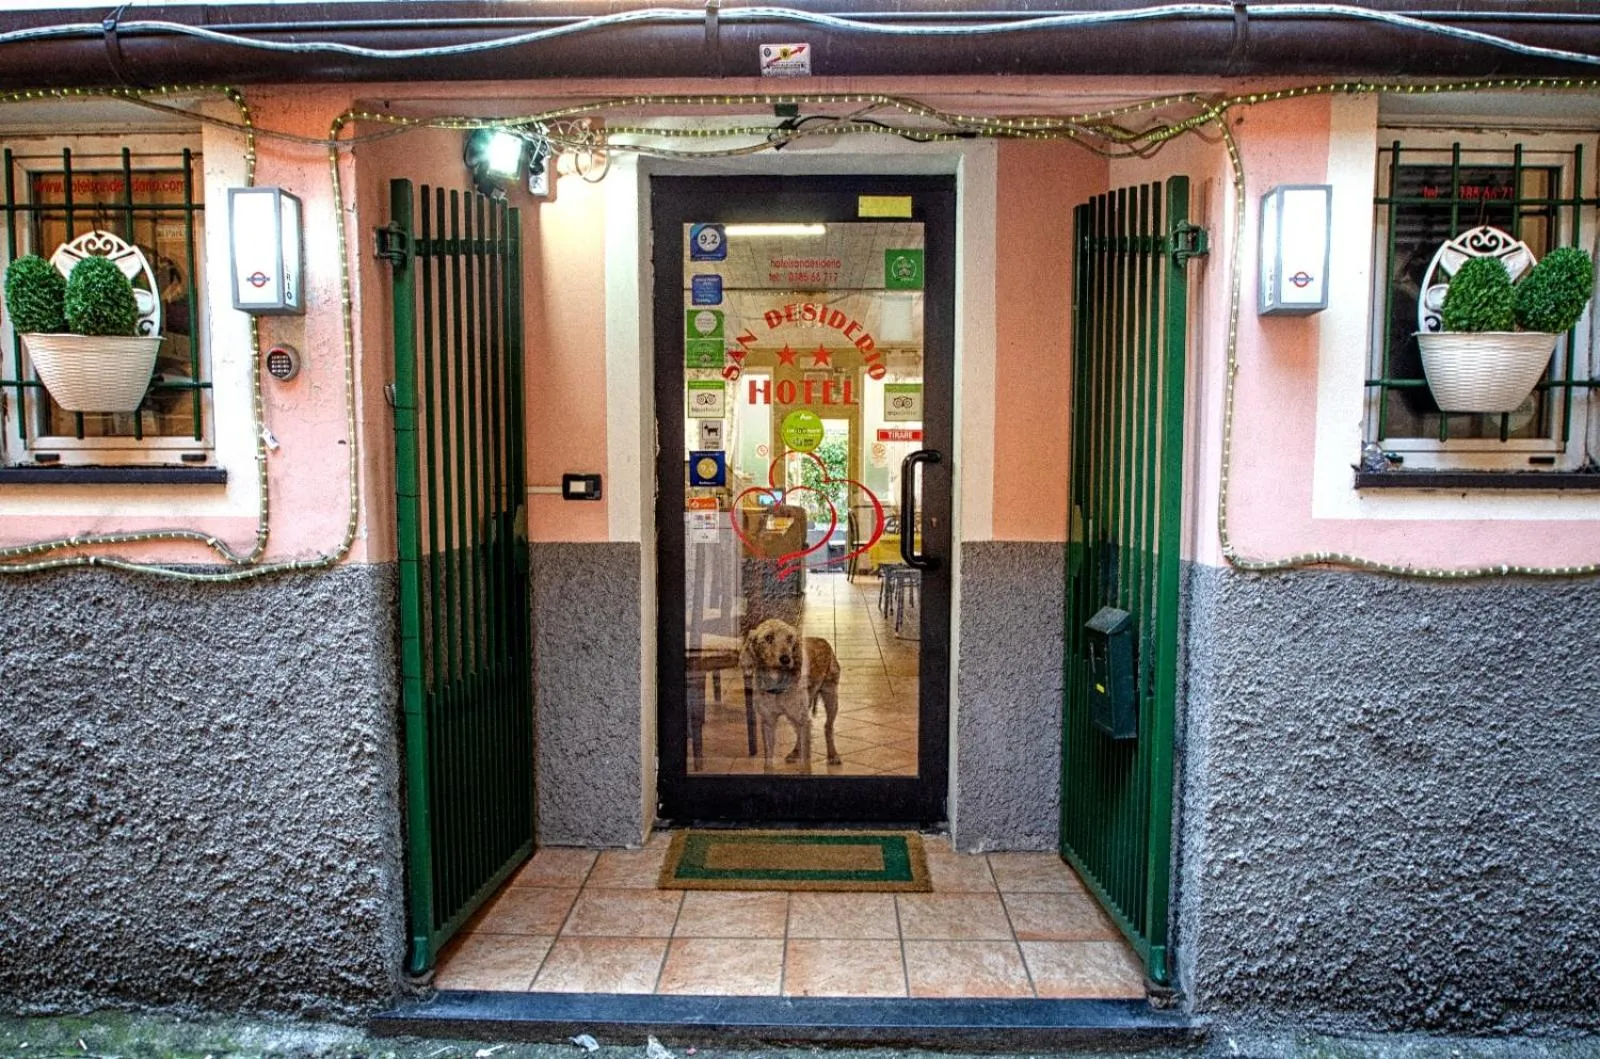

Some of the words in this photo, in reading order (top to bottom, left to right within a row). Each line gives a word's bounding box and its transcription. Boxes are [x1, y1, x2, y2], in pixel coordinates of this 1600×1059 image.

[700, 234, 718, 245] 9,2
[824, 272, 839, 282] 717
[721, 328, 758, 381] SAN
[764, 303, 887, 380] DESIDERIO
[749, 379, 859, 405] HOTEL
[889, 431, 912, 440] TIRARE
